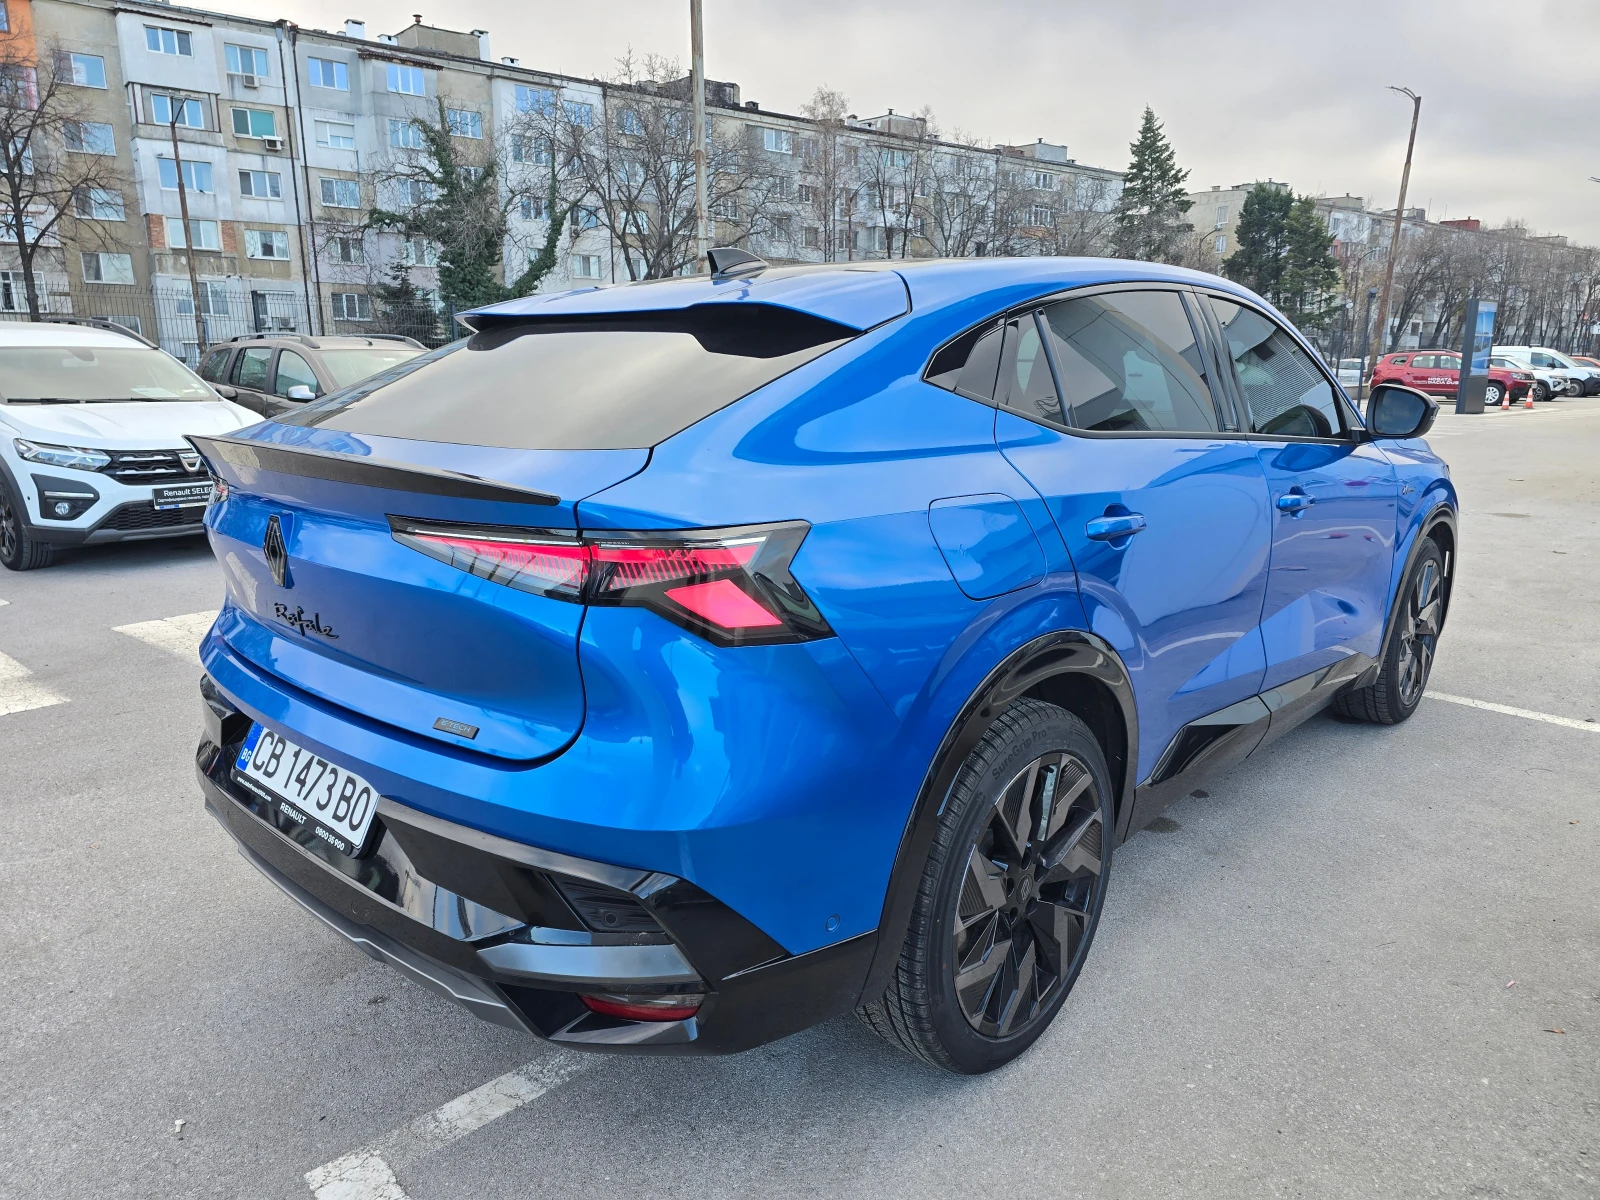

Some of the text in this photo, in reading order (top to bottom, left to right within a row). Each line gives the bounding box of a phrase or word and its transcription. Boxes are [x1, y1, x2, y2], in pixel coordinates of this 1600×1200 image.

[163, 489, 191, 497] Renault
[274, 602, 339, 639] Rafale
[1032, 729, 1047, 742] Pro
[241, 748, 252, 762] BG
[252, 730, 287, 779] CB
[283, 747, 339, 811] 1473
[279, 802, 307, 825] RENAULT
